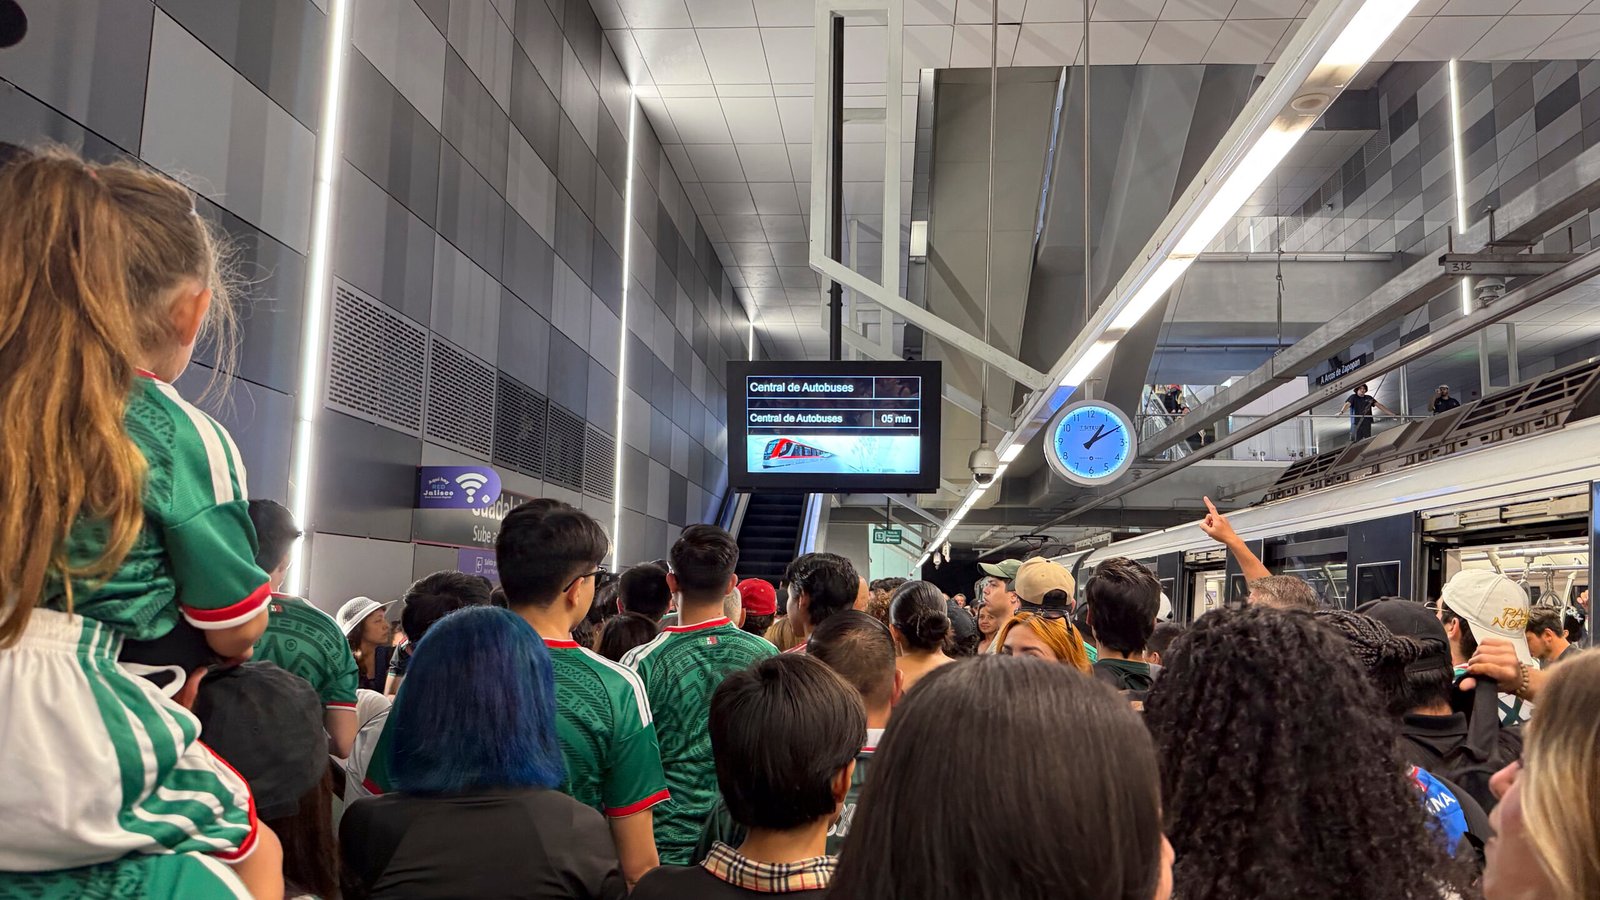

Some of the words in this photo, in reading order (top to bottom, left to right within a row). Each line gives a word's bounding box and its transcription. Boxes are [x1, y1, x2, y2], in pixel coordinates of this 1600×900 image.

[1452, 261, 1472, 272] 312
[749, 382, 785, 393] Central
[787, 382, 801, 393] de
[802, 382, 855, 393] Autobuses
[1087, 410, 1095, 418] 12
[749, 413, 782, 424] Central
[783, 413, 796, 424] de
[796, 413, 843, 424] Autobuses
[881, 414, 893, 424] 05
[895, 414, 912, 424] min
[1063, 424, 1071, 432] 10
[1058, 438, 1064, 446] 9
[1120, 439, 1125, 447] 3
[1063, 452, 1069, 460] 8
[1074, 462, 1079, 470] 7
[1089, 466, 1094, 474] 6
[1104, 463, 1109, 471] 5
[472, 525, 491, 544] Sube
